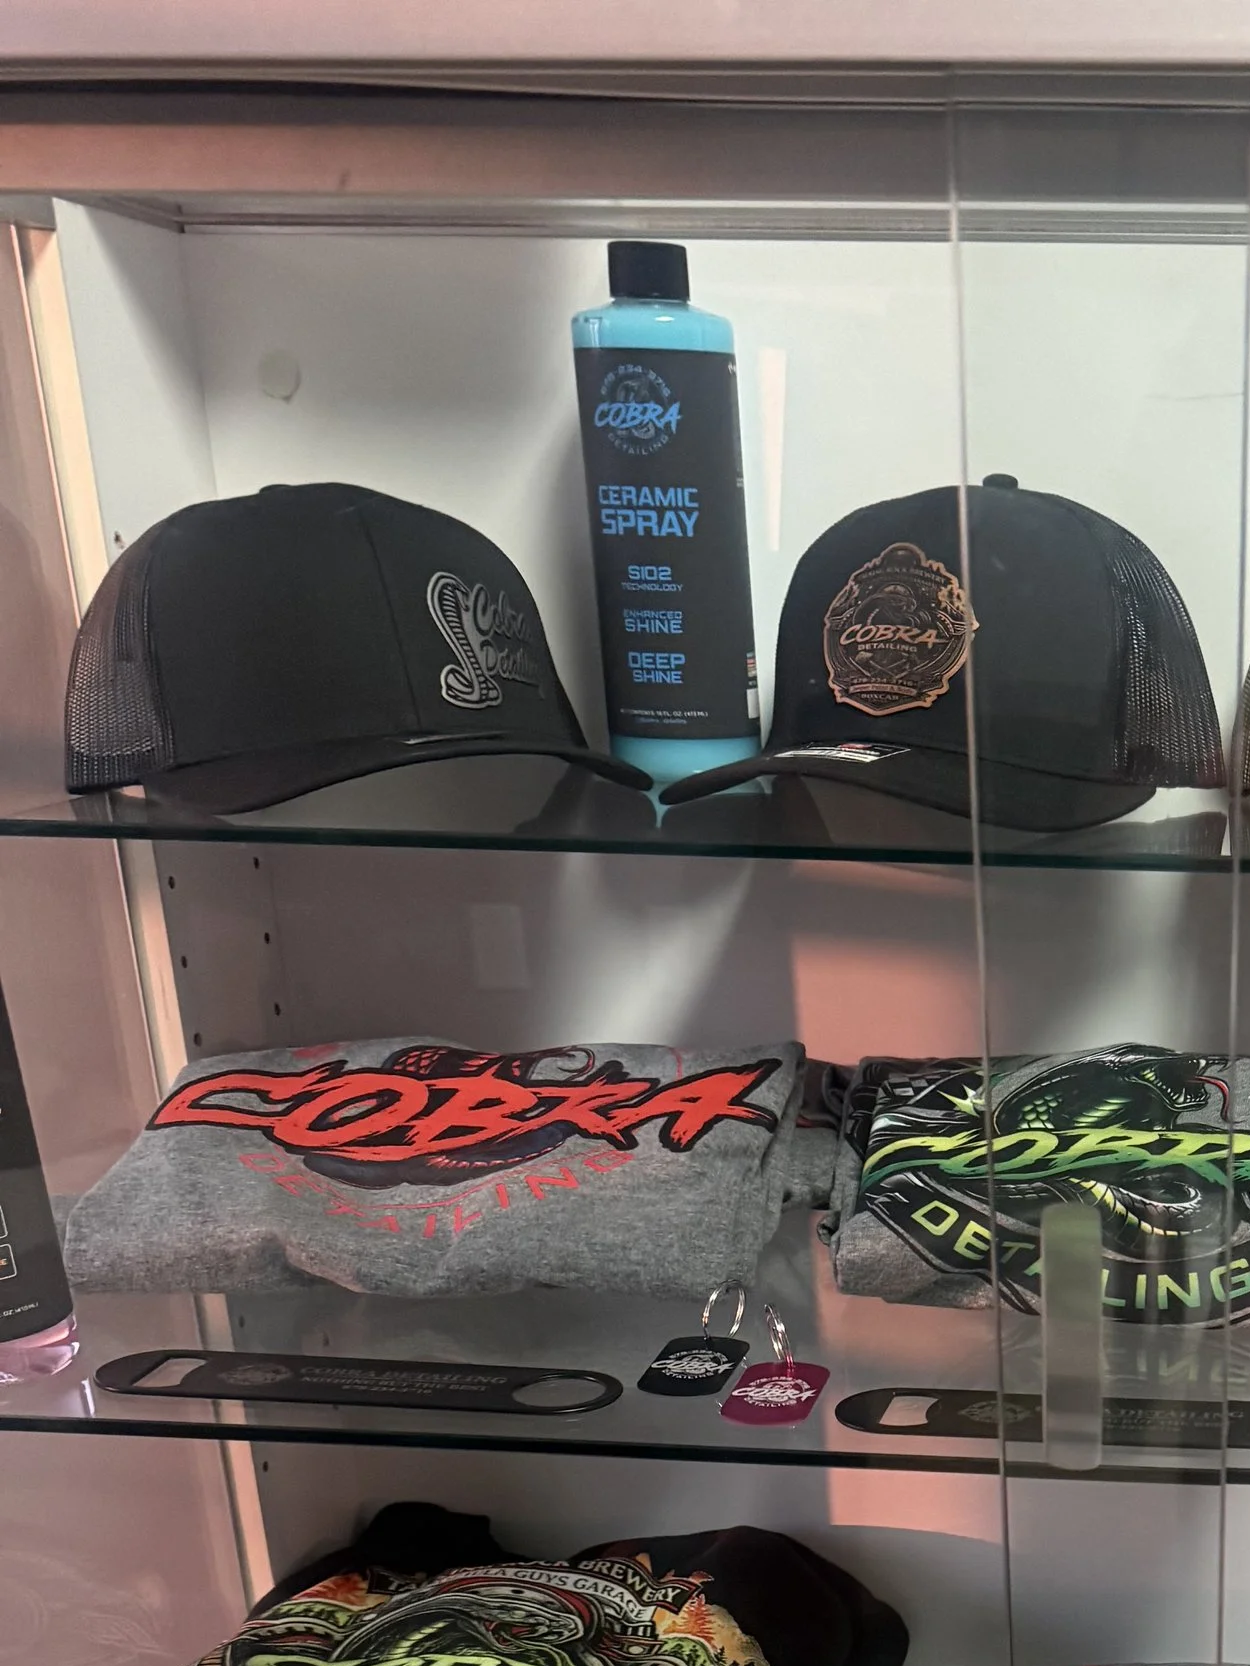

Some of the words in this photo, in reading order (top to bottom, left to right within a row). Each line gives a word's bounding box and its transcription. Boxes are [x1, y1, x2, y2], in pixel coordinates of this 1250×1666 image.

[593, 401, 683, 434] COBRA
[607, 432, 670, 456] DETAILING
[598, 485, 700, 508] CERAMIC
[601, 508, 700, 537] SPRAY
[621, 582, 684, 593] TECHNOLOGY
[623, 608, 683, 620] ENHANCED
[625, 619, 684, 634] SHINE
[840, 623, 950, 649] COBRA
[858, 643, 918, 653] DETAILING
[627, 651, 686, 669] DEEP
[632, 669, 684, 684] SHINE
[148, 1059, 782, 1164] COBRA
[238, 1149, 637, 1240] DETAILING
[301, 1366, 376, 1379] COBRA
[651, 1358, 736, 1374] COBRA
[731, 1387, 818, 1403] COBRA
[577, 1559, 681, 1604] BREWERY
[513, 1569, 569, 1589] GUYS
[572, 1578, 646, 1620] GARAGE
